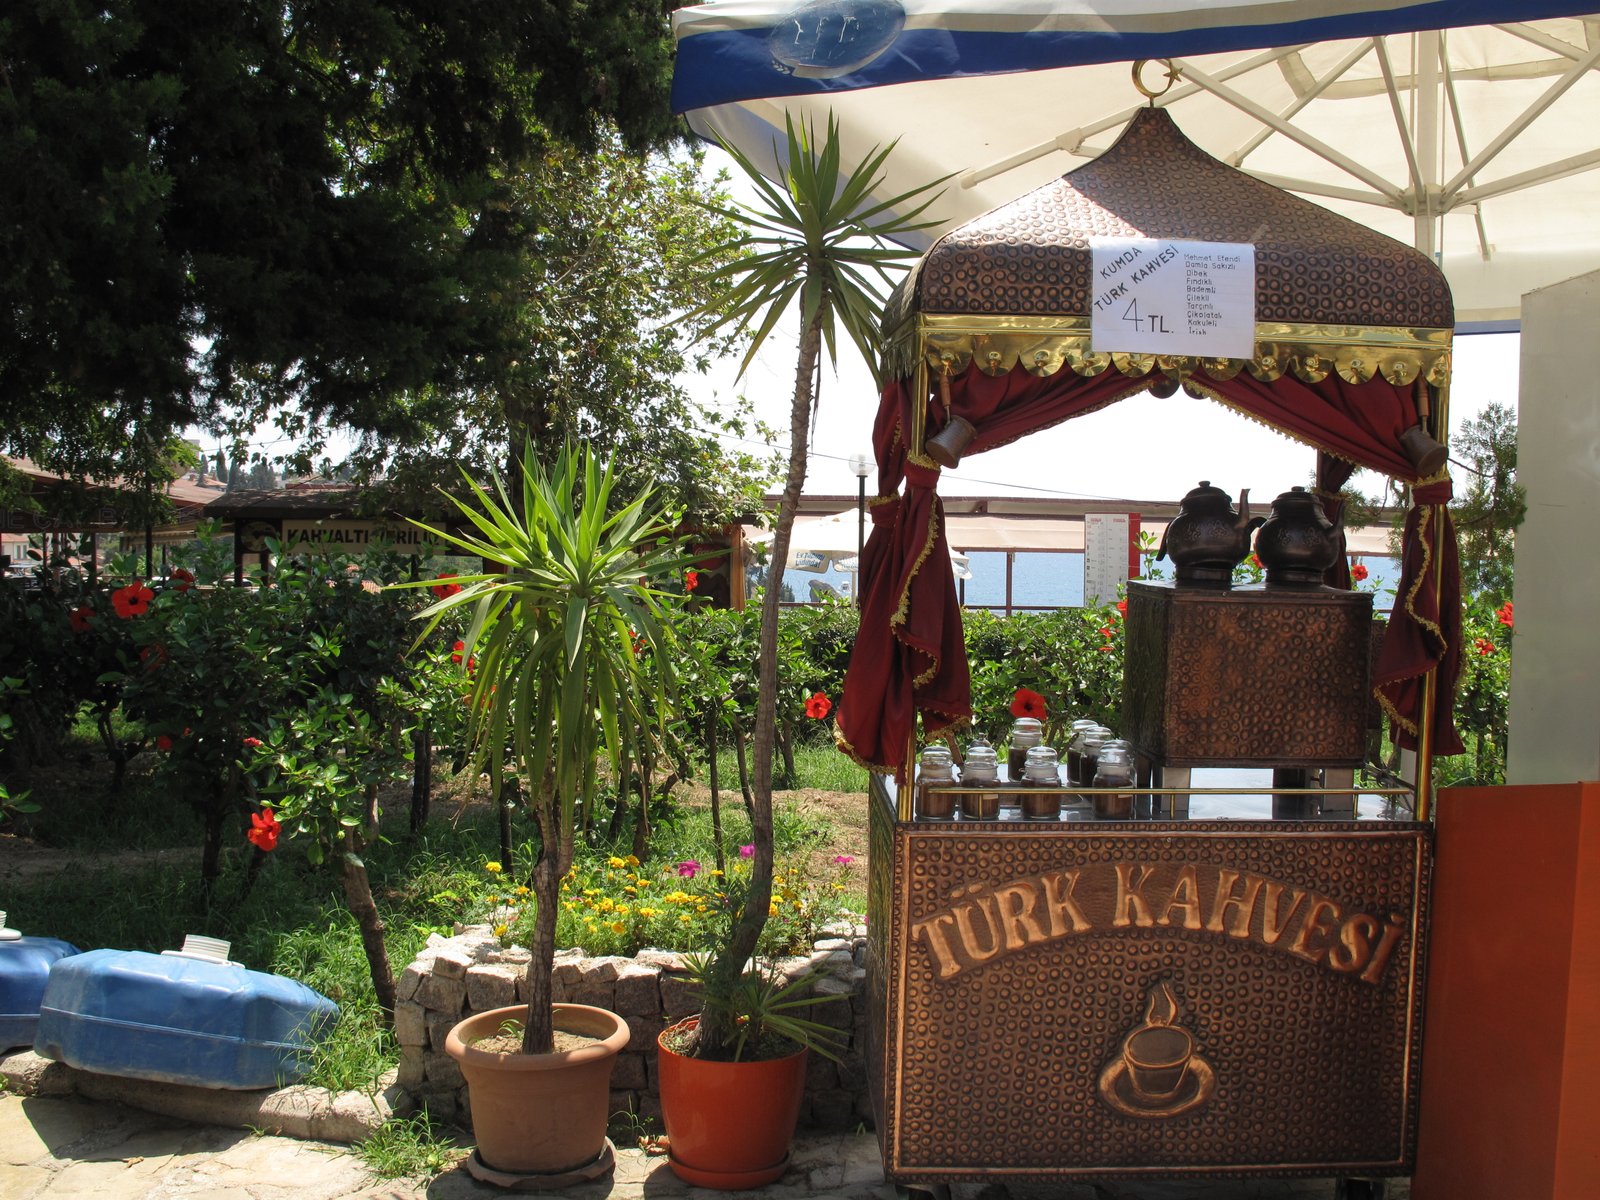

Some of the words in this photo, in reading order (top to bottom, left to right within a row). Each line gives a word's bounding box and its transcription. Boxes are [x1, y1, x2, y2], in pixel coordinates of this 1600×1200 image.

[1093, 282, 1129, 311] TÜRK
[1130, 243, 1179, 284] KAHVESİ
[1099, 247, 1142, 279] KUMDA
[1185, 260, 1208, 269] Damla
[287, 528, 369, 543] KAHVALTI
[911, 871, 1093, 977] TÜRK
[1112, 863, 1405, 984] KAHVESİ
